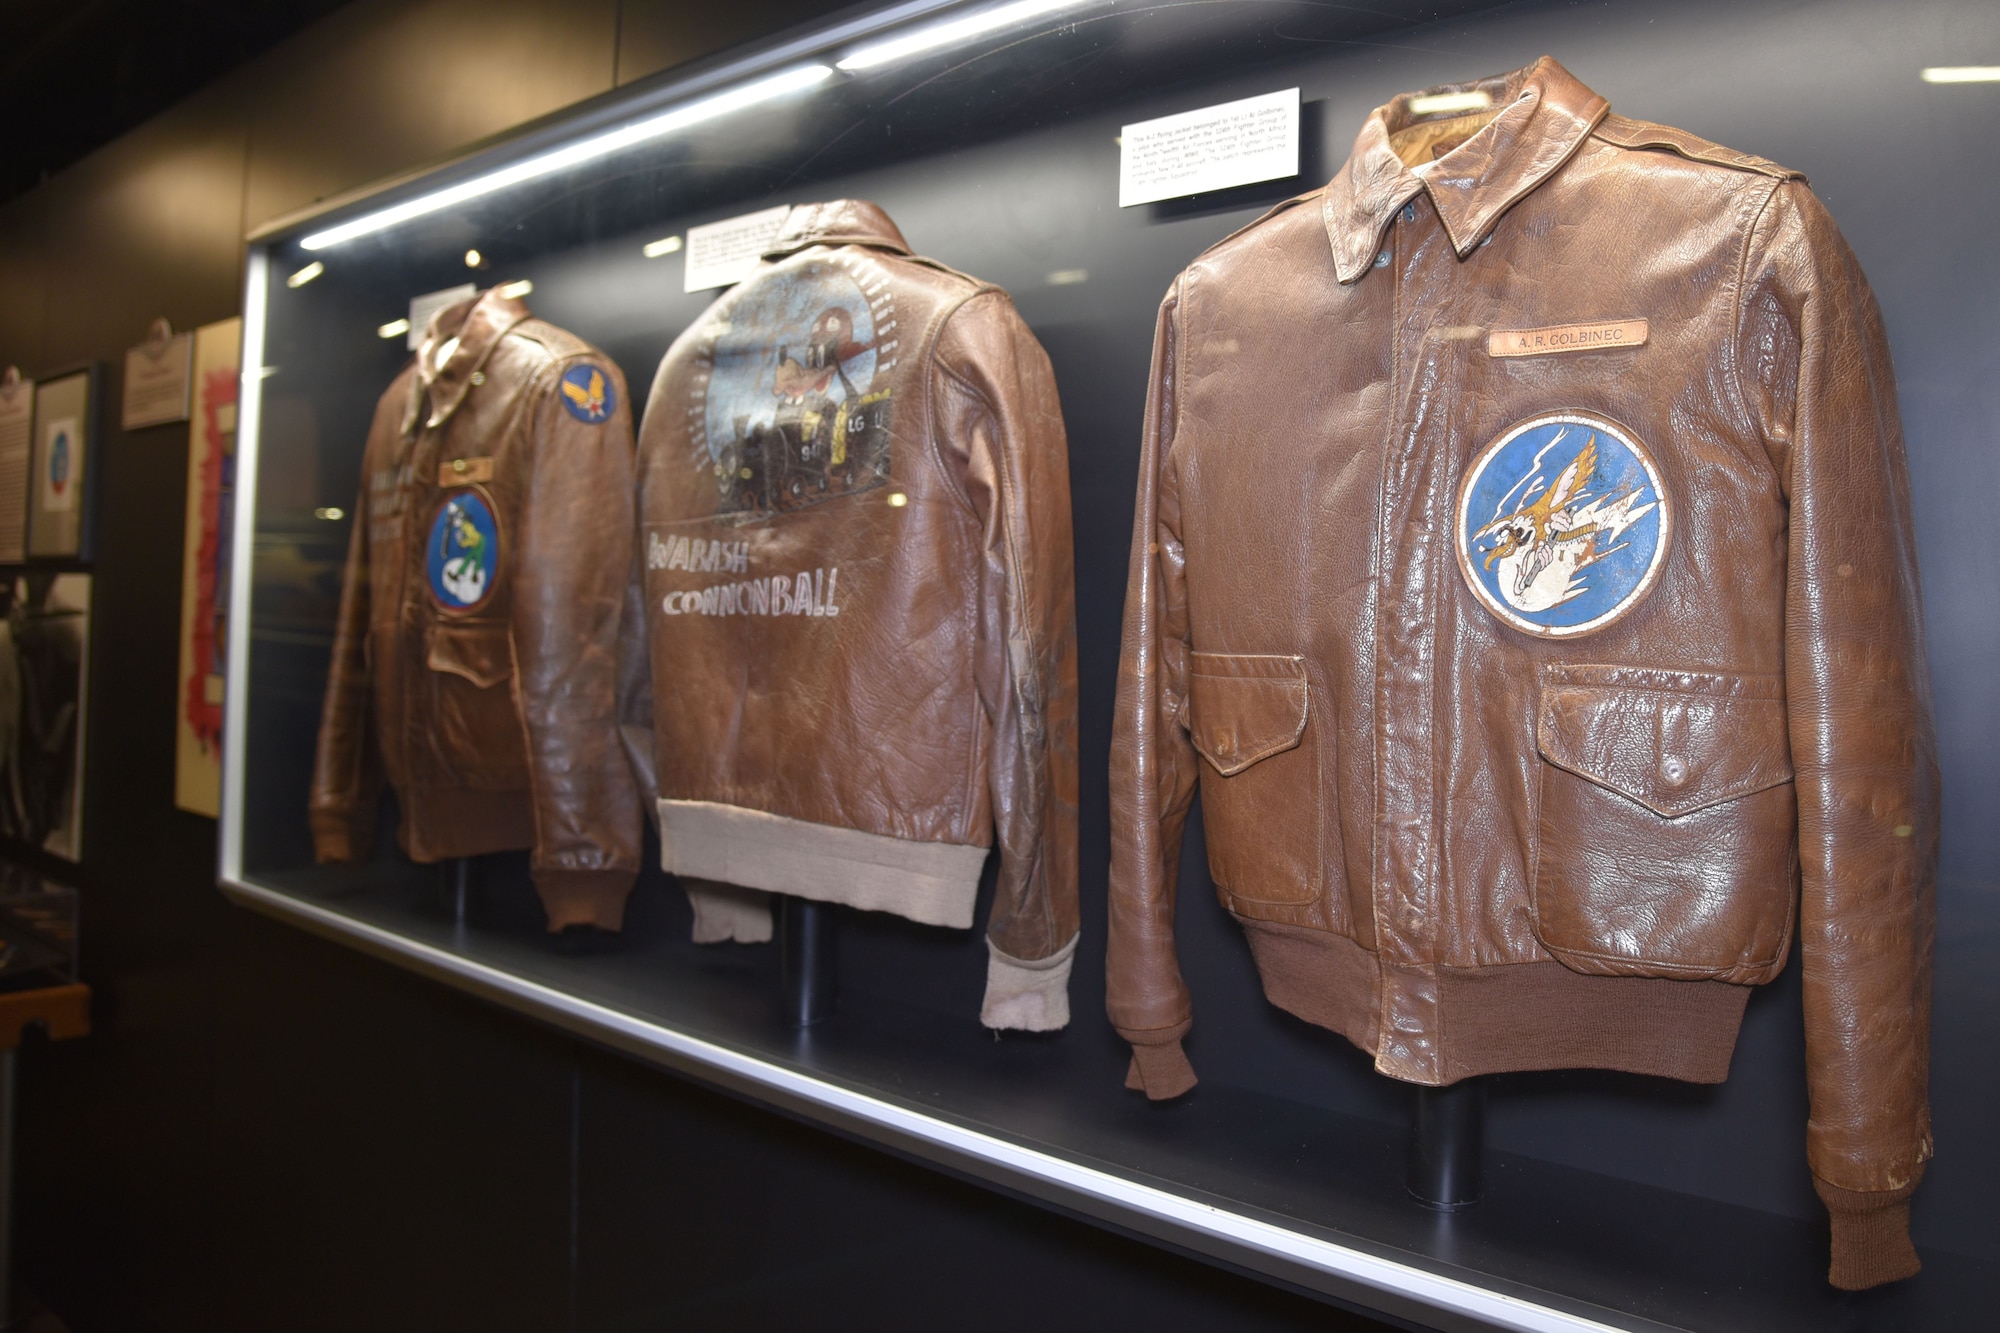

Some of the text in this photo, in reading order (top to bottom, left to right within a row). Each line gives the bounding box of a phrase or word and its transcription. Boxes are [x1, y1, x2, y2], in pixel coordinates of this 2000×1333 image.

[1518, 337, 1531, 348] A.
[1534, 336, 1546, 347] R.
[648, 531, 749, 574] WABASH
